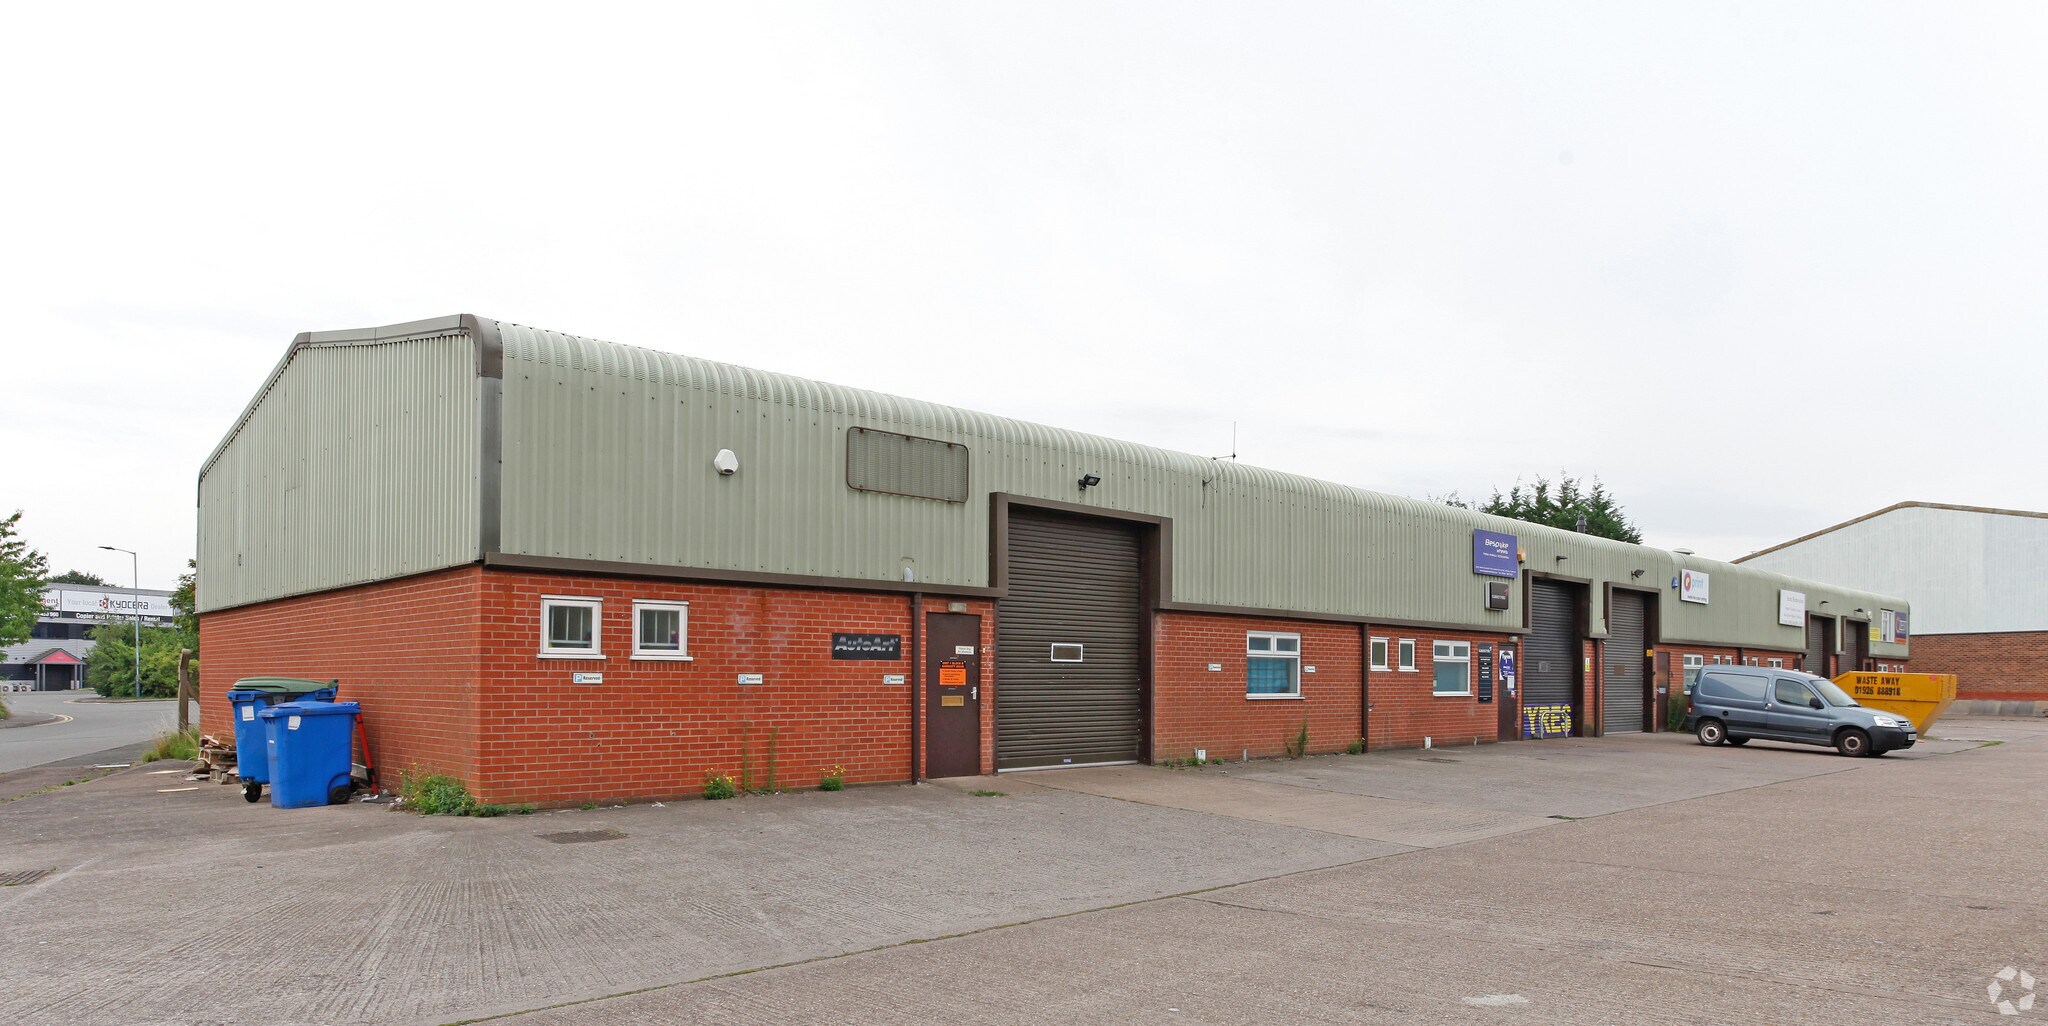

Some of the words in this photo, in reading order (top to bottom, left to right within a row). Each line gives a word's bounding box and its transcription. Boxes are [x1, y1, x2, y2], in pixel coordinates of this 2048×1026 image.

[1856, 676, 1878, 685] WASTE
[1881, 677, 1901, 686] AWAY
[1855, 686, 1874, 695] 01926
